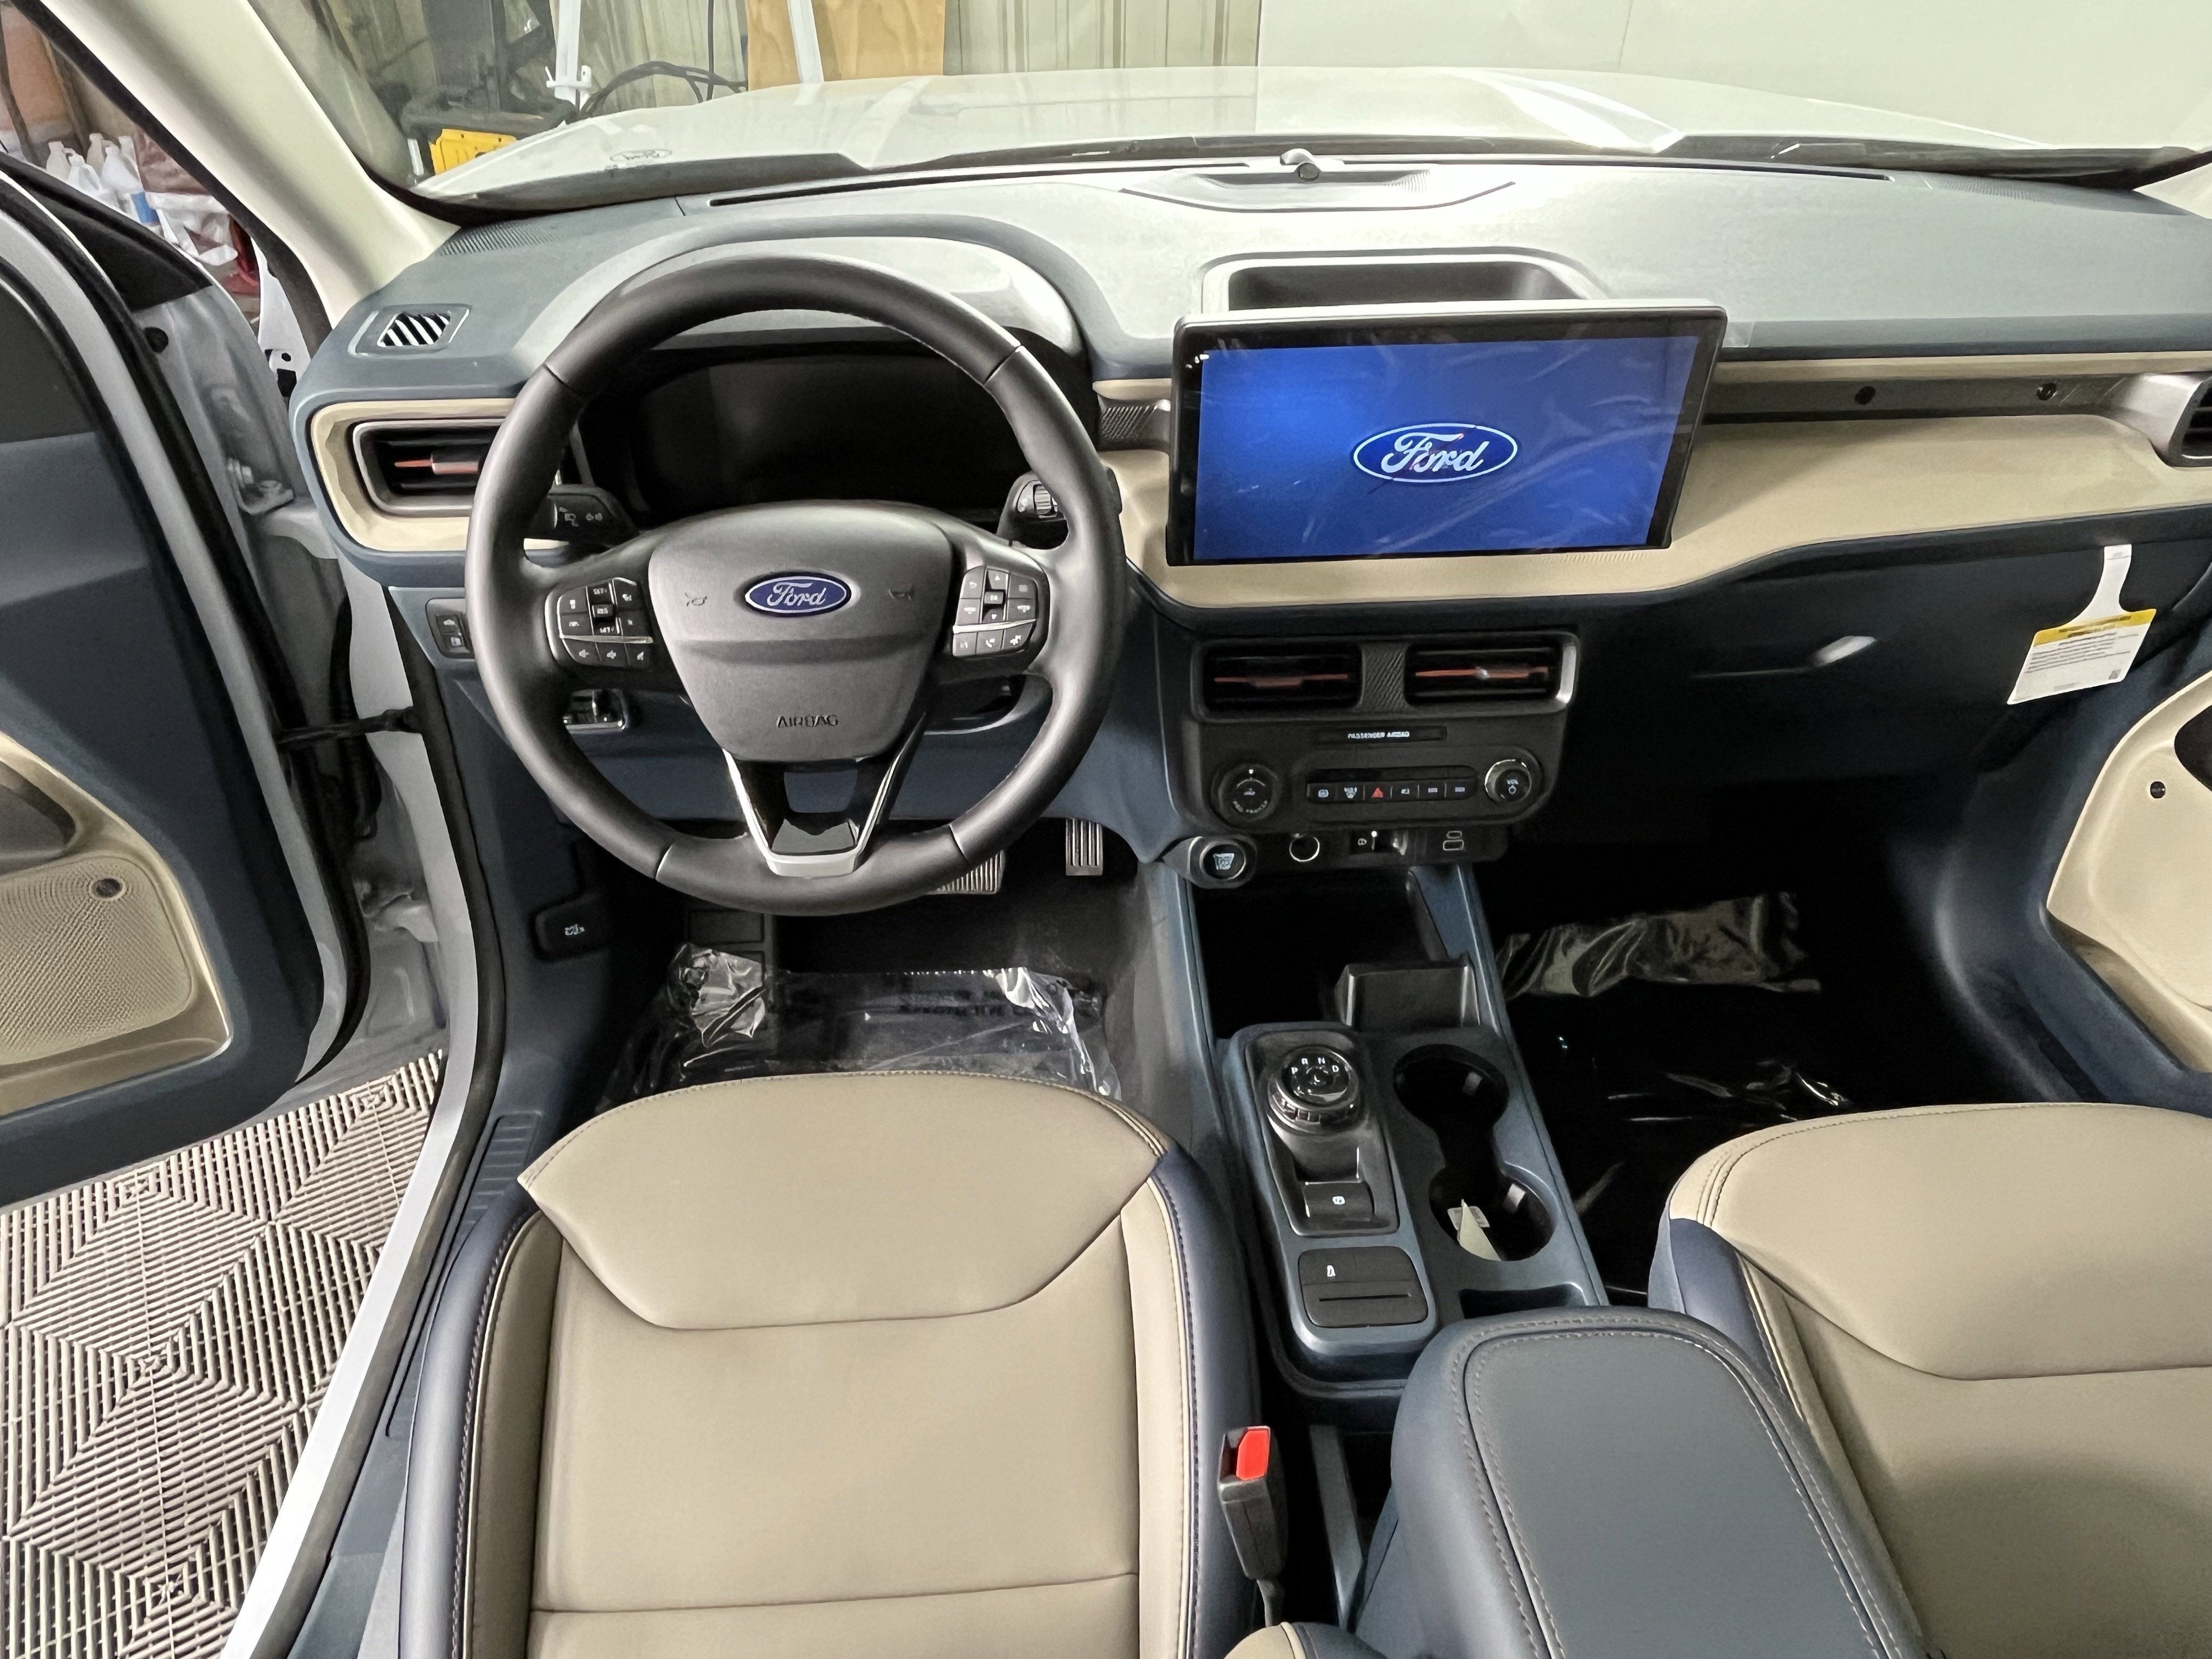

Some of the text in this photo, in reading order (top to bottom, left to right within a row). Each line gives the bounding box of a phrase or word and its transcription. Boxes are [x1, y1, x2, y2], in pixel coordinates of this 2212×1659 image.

[1381, 432, 1489, 473] Ford
[767, 582, 827, 606] Ford
[776, 714, 838, 727] AIRBAG
